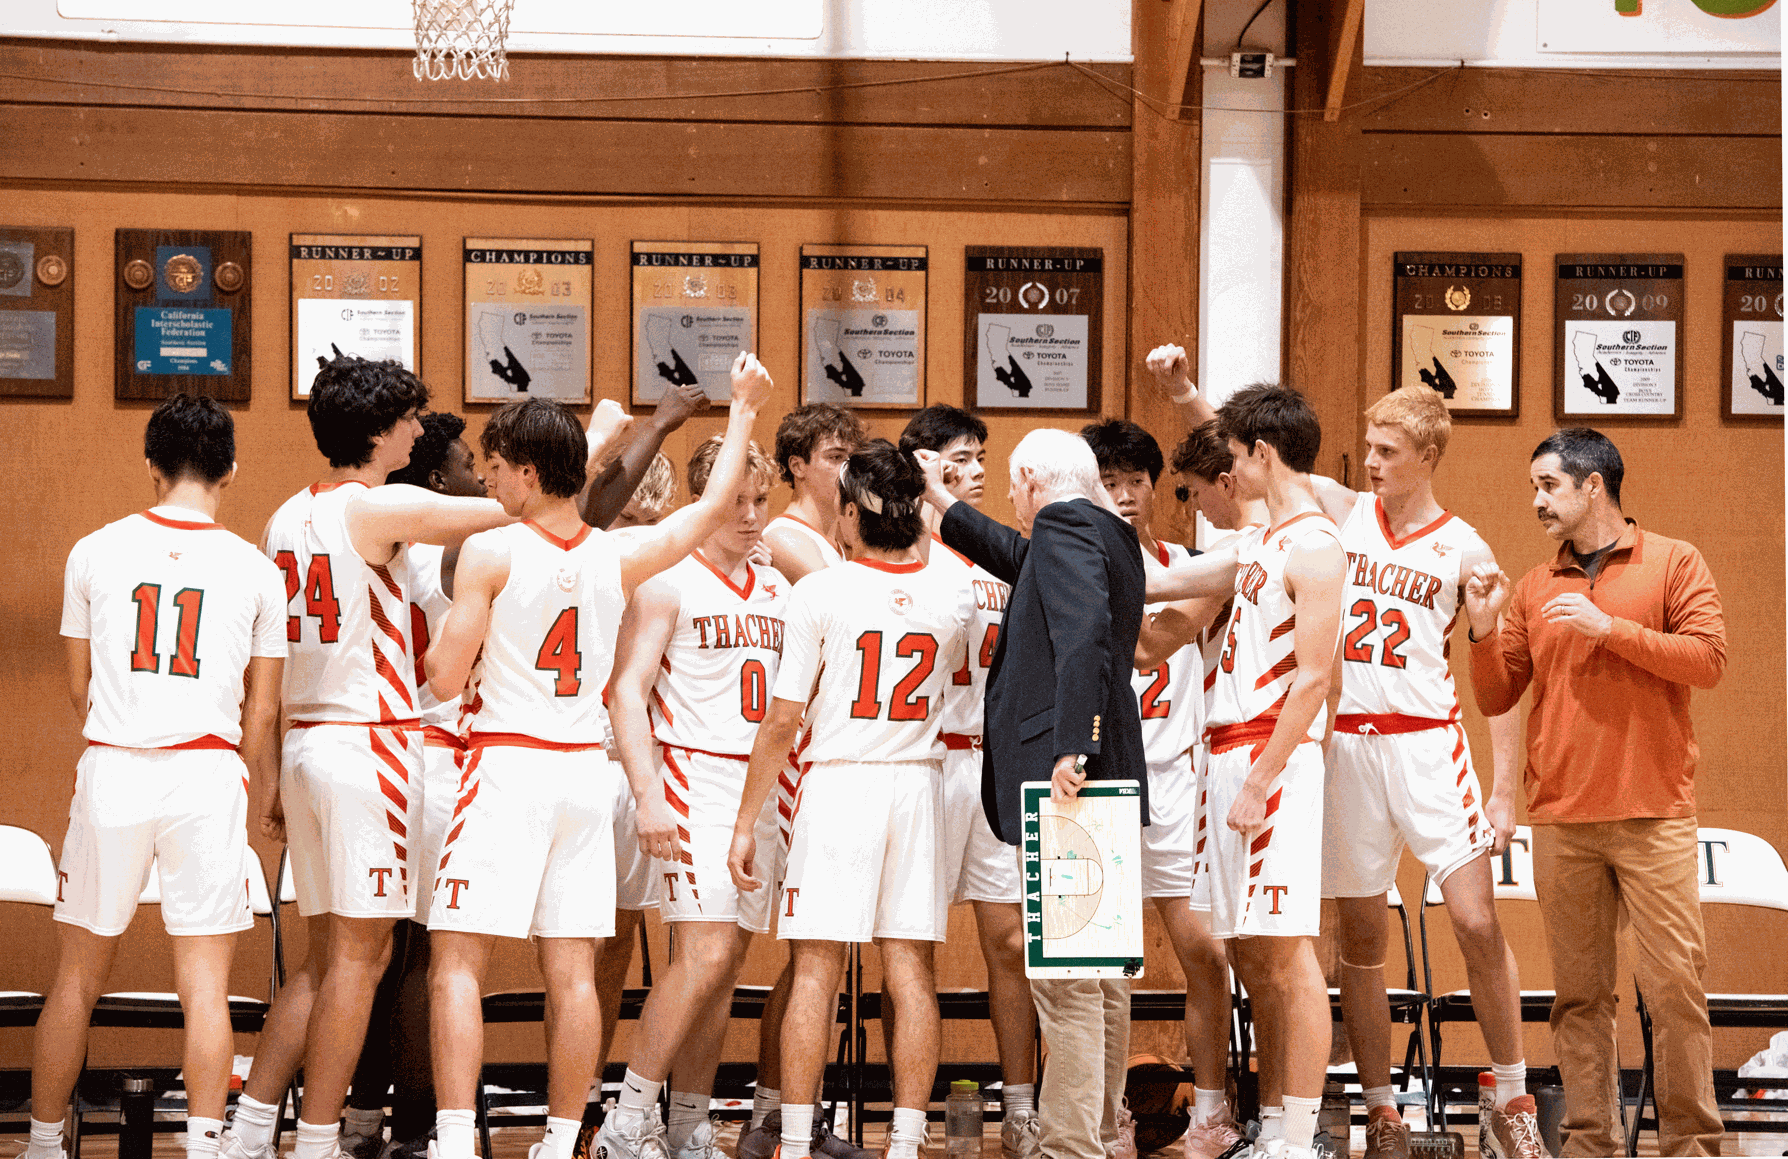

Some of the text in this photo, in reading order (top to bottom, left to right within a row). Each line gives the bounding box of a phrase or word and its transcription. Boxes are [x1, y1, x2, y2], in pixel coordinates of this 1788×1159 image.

[471, 251, 586, 264] CHAMPIONS
[986, 258, 1085, 271] RUNNER-UP
[1406, 264, 1513, 278] CHAMPIONS
[1575, 266, 1667, 277] RUNNER-UP
[313, 274, 400, 292] 20 02
[985, 286, 1081, 305] 20 07
[1572, 294, 1669, 311] 20 09
[1740, 295, 1767, 312] 20
[151, 319, 214, 329] Interscholastic
[160, 311, 205, 320] California
[161, 328, 206, 337] Federation
[844, 328, 882, 336] Southern
[1009, 336, 1048, 345] Southern
[878, 350, 914, 358] TOYOTA
[1037, 352, 1067, 360] TOYOTA
[1464, 350, 1495, 358] TOYOTA
[1596, 343, 1635, 351] Southern
[1345, 551, 1443, 611] THACHER
[274, 550, 342, 644] 24
[130, 582, 205, 680] 11
[1344, 598, 1411, 670] 22
[1220, 606, 1242, 675] 5
[535, 606, 582, 698] 4
[850, 630, 940, 722] 12
[740, 658, 767, 723] 0
[1698, 840, 1730, 889] T
[369, 867, 393, 897] T
[1025, 811, 1042, 943] THACHER
[445, 878, 469, 910] T
[664, 872, 679, 902] T
[785, 887, 800, 917] T
[1263, 885, 1288, 915] T
